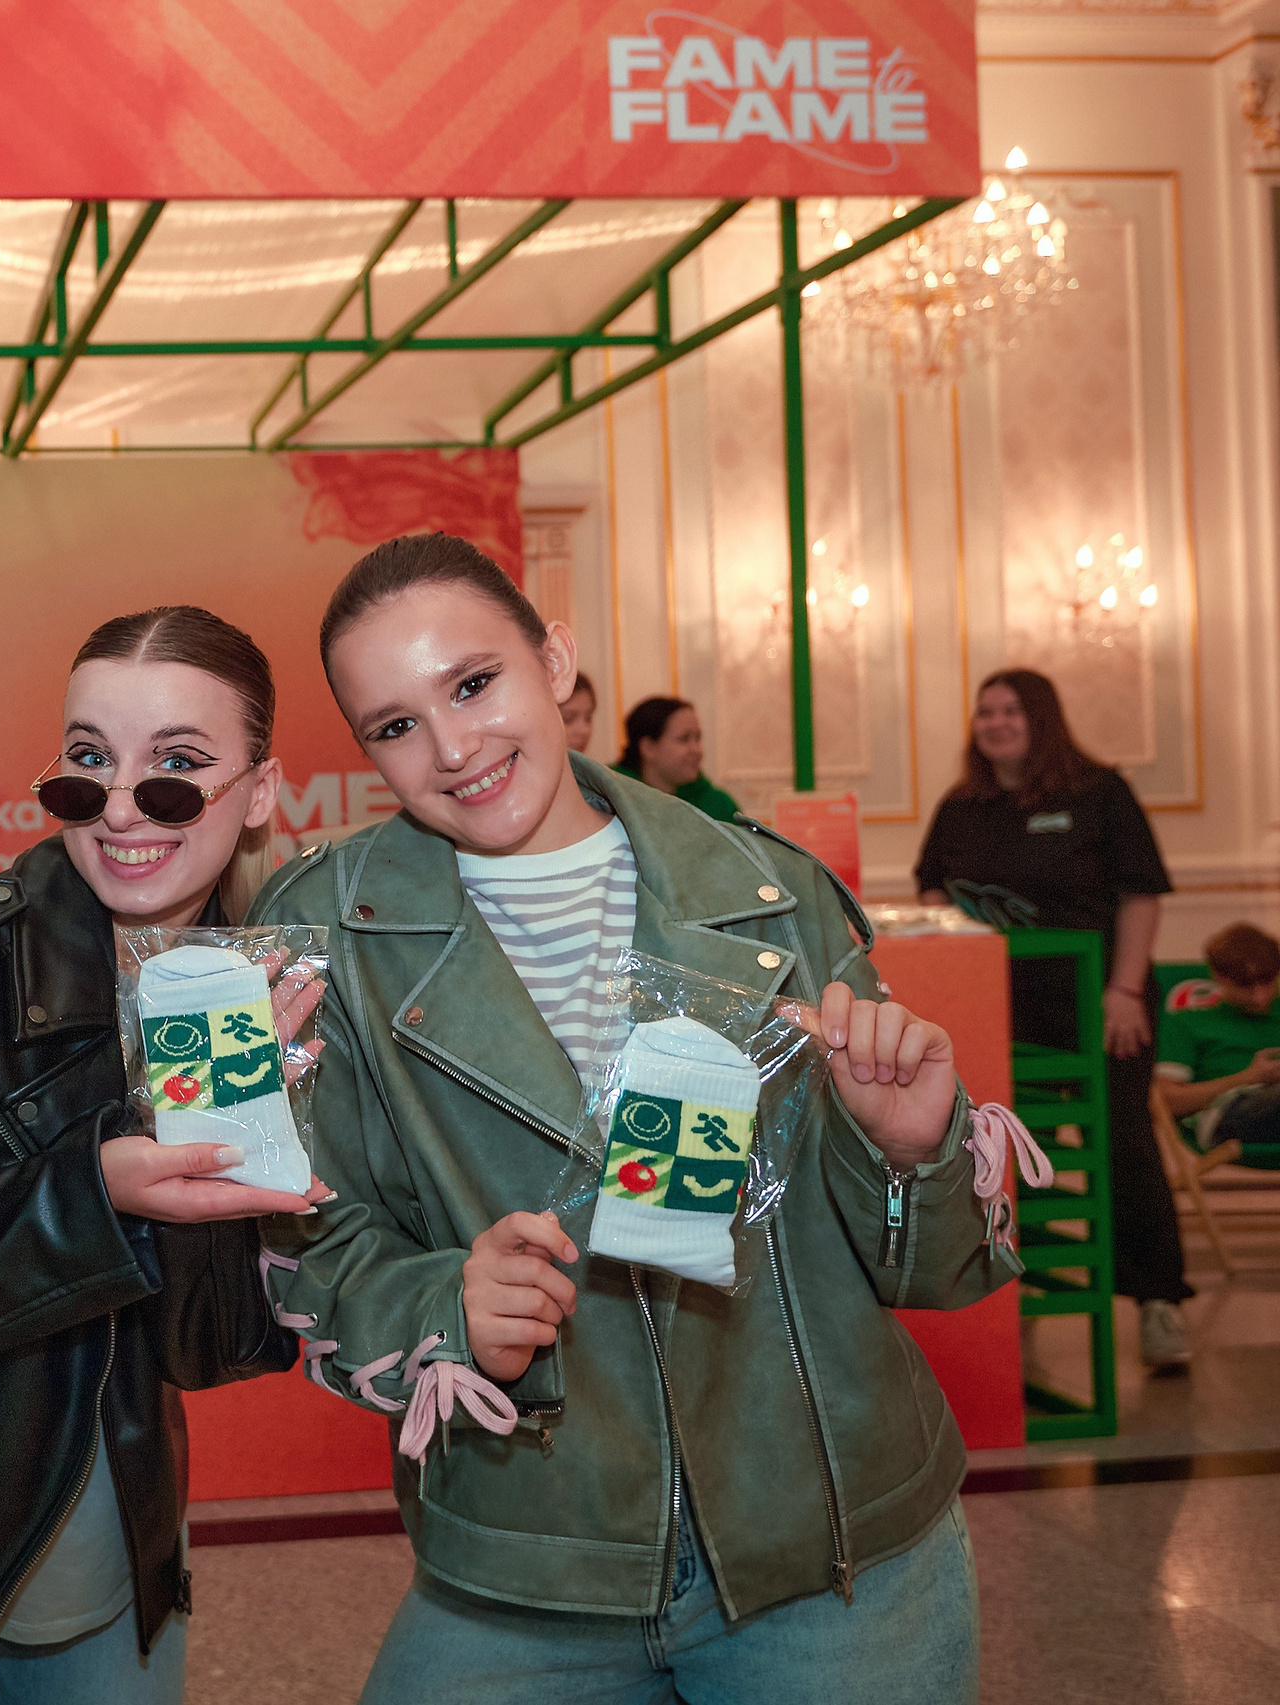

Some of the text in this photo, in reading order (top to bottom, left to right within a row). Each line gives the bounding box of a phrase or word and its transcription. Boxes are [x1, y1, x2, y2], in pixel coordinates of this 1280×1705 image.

[609, 36, 870, 88] FAME
[611, 91, 928, 142] FLAME
[277, 771, 404, 831] ME
